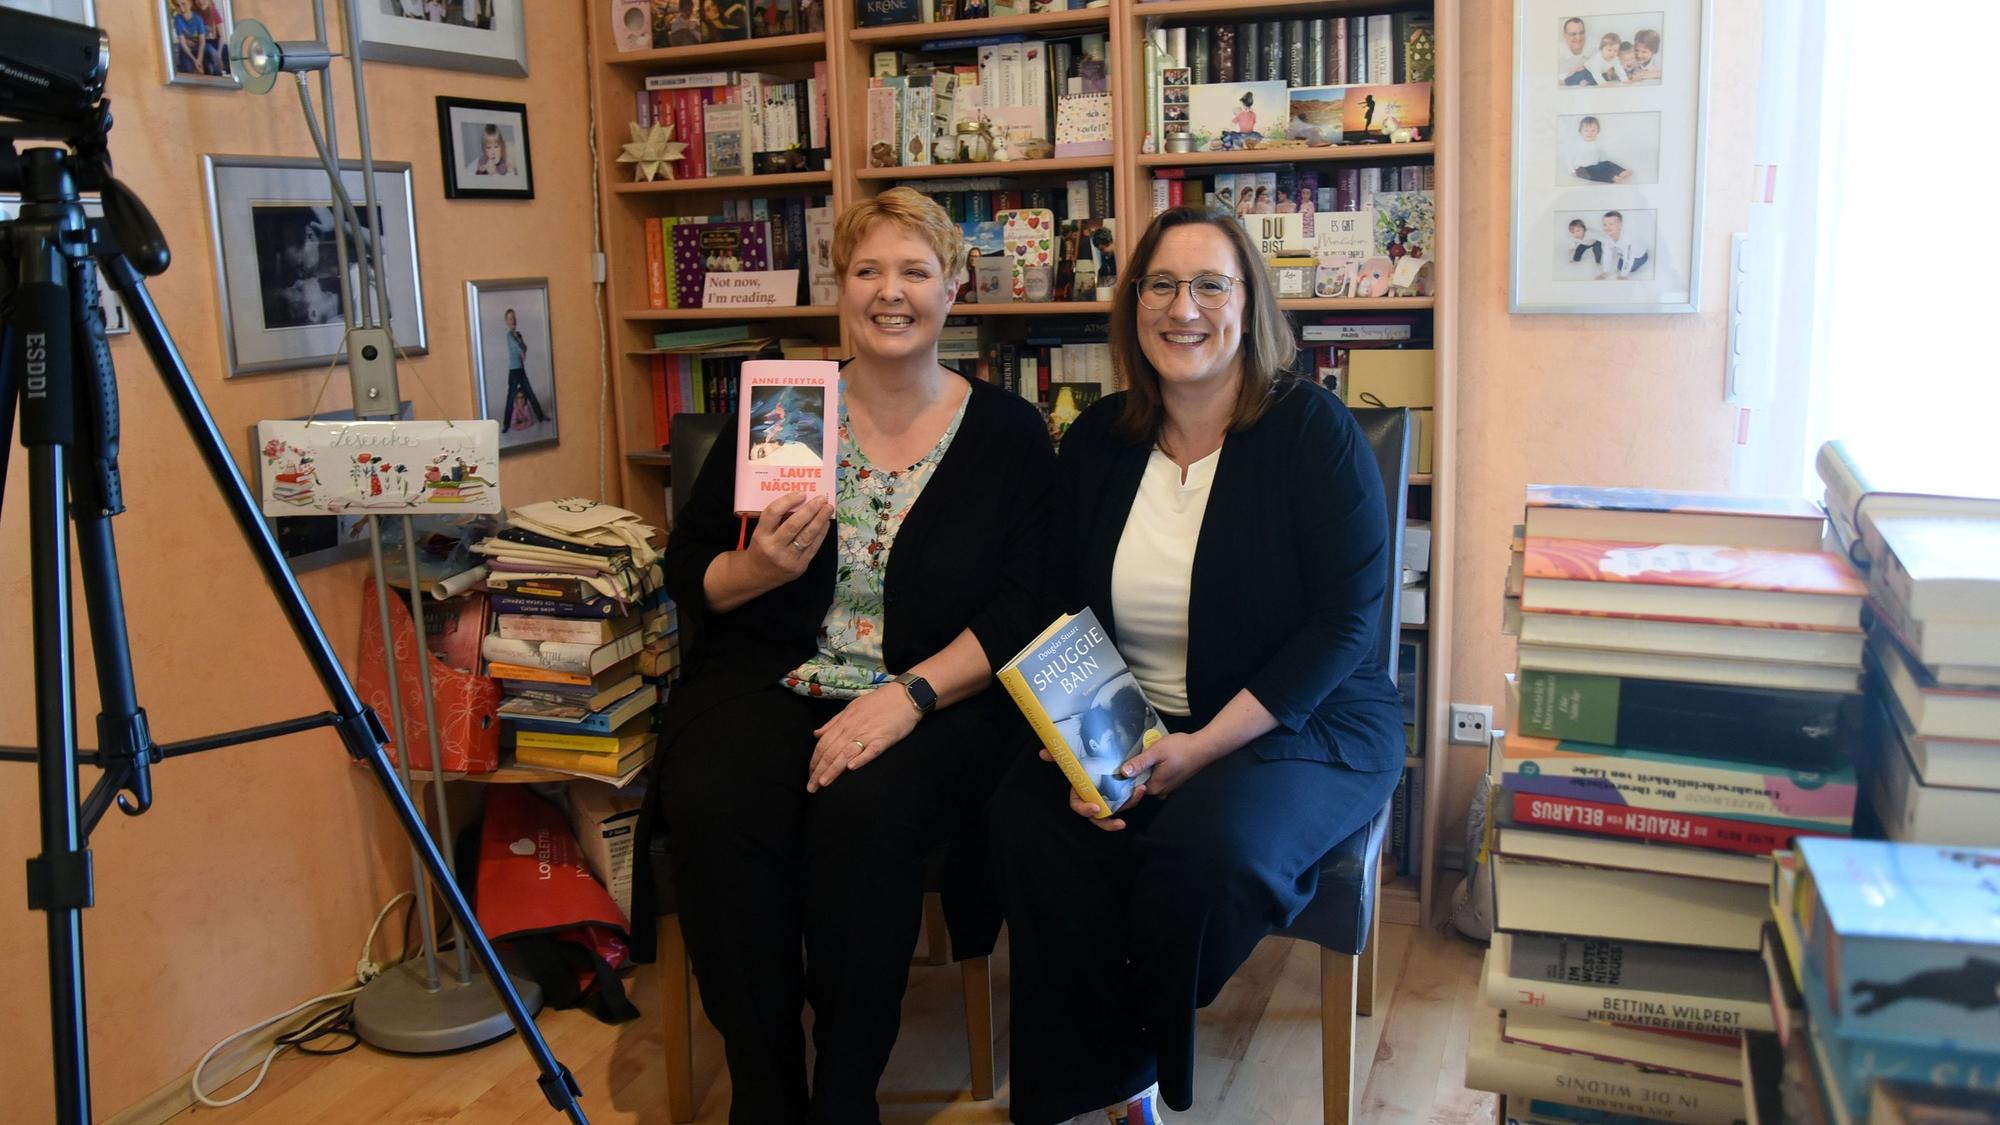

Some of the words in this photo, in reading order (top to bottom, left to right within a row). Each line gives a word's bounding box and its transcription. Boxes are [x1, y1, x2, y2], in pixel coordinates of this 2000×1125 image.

[1262, 216, 1285, 239] DU
[1262, 241, 1285, 253] BIST
[709, 277, 731, 288] Not
[734, 277, 761, 287] now,
[708, 293, 729, 303] I'm
[730, 292, 777, 304] reading.
[26, 333, 47, 400] ESDDI
[780, 468, 822, 478] LAUTE
[761, 478, 817, 492] NÄCHTE
[1037, 640, 1062, 662] Douglas
[1060, 625, 1080, 644] Stuart
[1033, 626, 1103, 692] SHUGGIE
[1059, 655, 1100, 694] BAIN
[1571, 766, 1608, 780] Liebe
[1530, 800, 1605, 827] BELARUS
[1625, 813, 1690, 837] FRAUEN
[1602, 997, 1666, 1017] BETTINA
[1672, 1004, 1741, 1025] WILPERT
[1554, 1074, 1632, 1098] WILDNIS
[1640, 1087, 1671, 1105] DIE
[1679, 1094, 1699, 1109] IN
